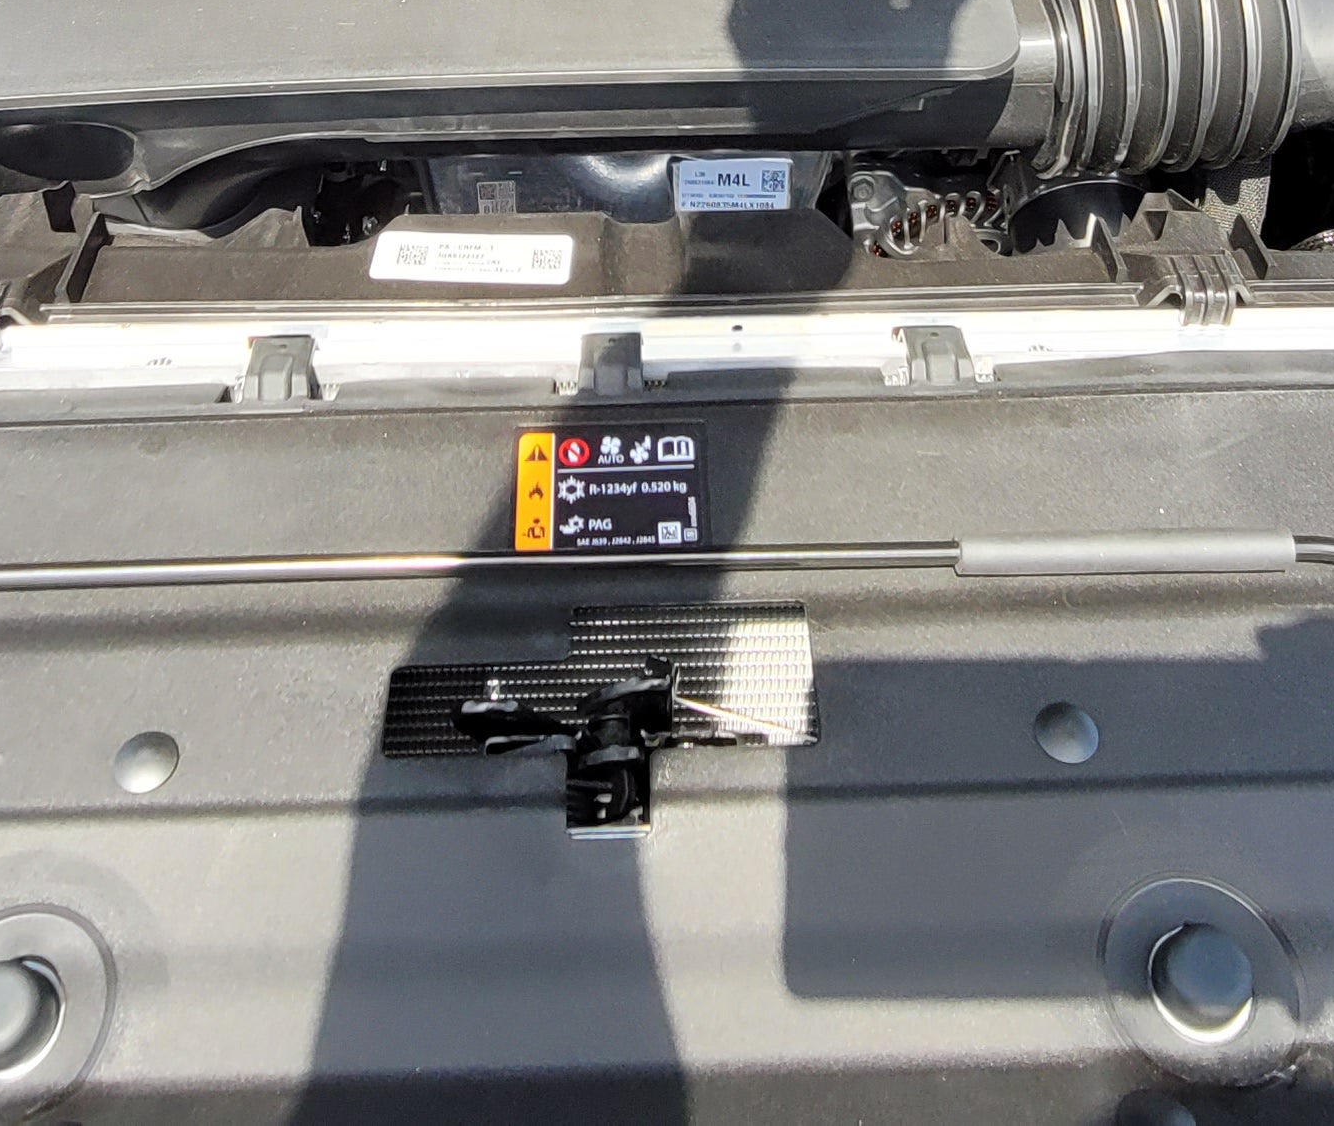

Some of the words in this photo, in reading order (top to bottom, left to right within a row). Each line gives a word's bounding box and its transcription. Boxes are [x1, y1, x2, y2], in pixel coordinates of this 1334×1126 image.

[717, 173, 750, 187] M4L
[597, 454, 624, 465] AUTO
[589, 482, 637, 496] R-1234yf
[641, 481, 671, 493] 0.520
[673, 480, 687, 495] kg
[588, 518, 613, 531] PAG
